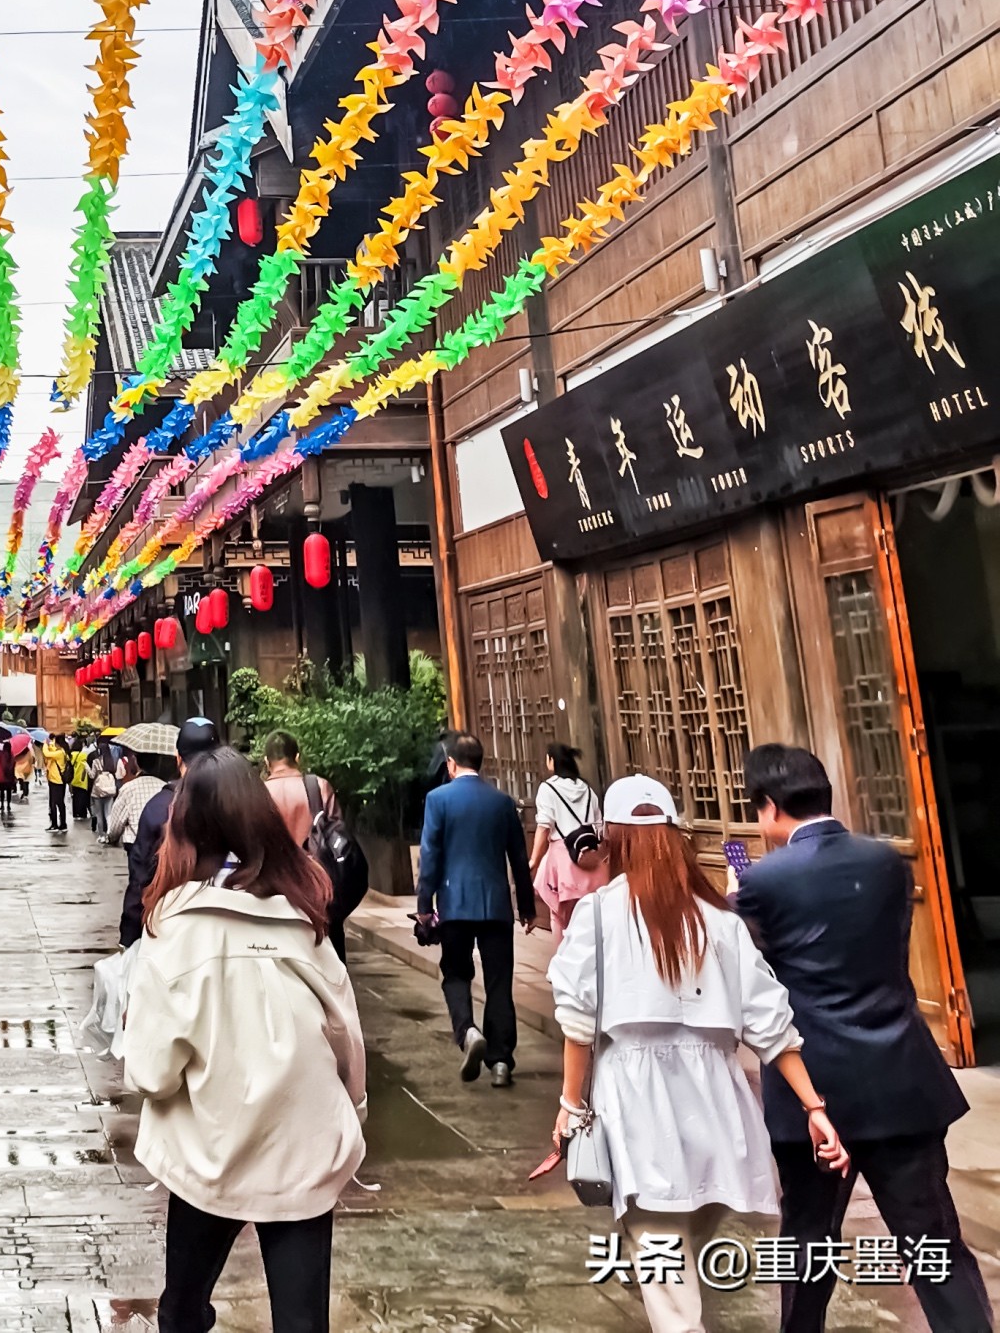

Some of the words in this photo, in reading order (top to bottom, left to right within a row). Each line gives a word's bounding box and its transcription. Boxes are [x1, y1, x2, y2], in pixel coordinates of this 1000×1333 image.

[564, 270, 966, 511] 青年运动客栈
[645, 492, 672, 512] TOWN
[710, 467, 748, 493] YOUTH
[800, 429, 855, 463] SPORTS
[929, 386, 988, 422] HOTEL
